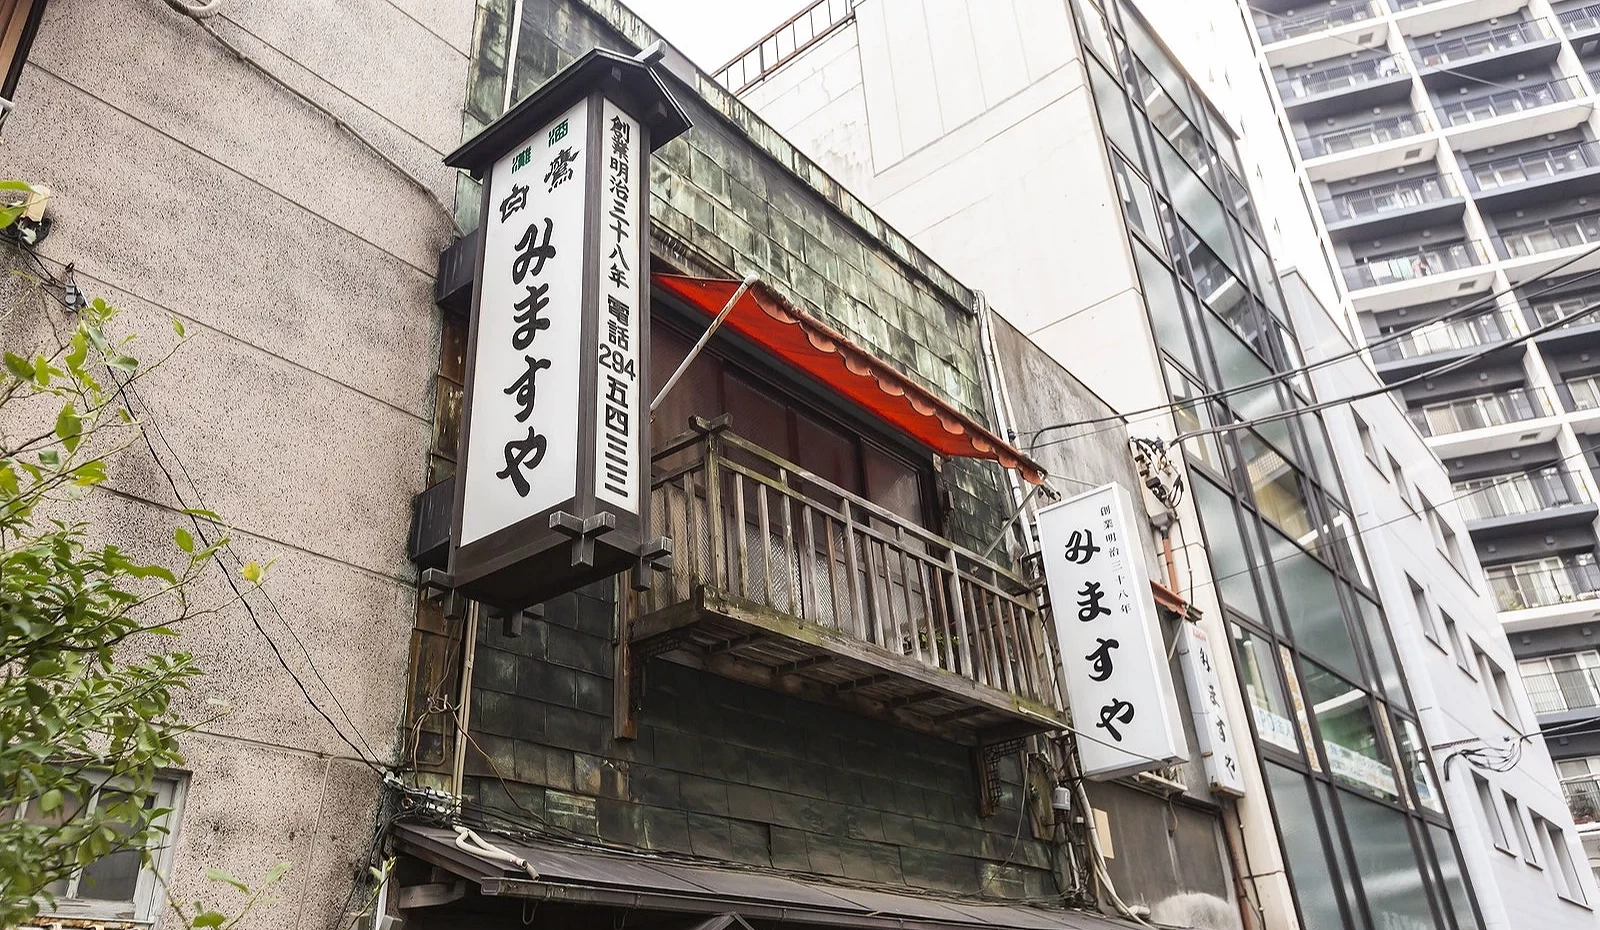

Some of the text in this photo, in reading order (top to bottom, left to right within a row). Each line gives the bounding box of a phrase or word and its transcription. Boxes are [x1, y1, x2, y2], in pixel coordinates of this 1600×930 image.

[607, 115, 631, 290] 創業明治三十八年
[496, 217, 557, 497] みますや
[1064, 528, 1135, 742] みますや
[1100, 504, 1132, 615] 創業明治三十八年
